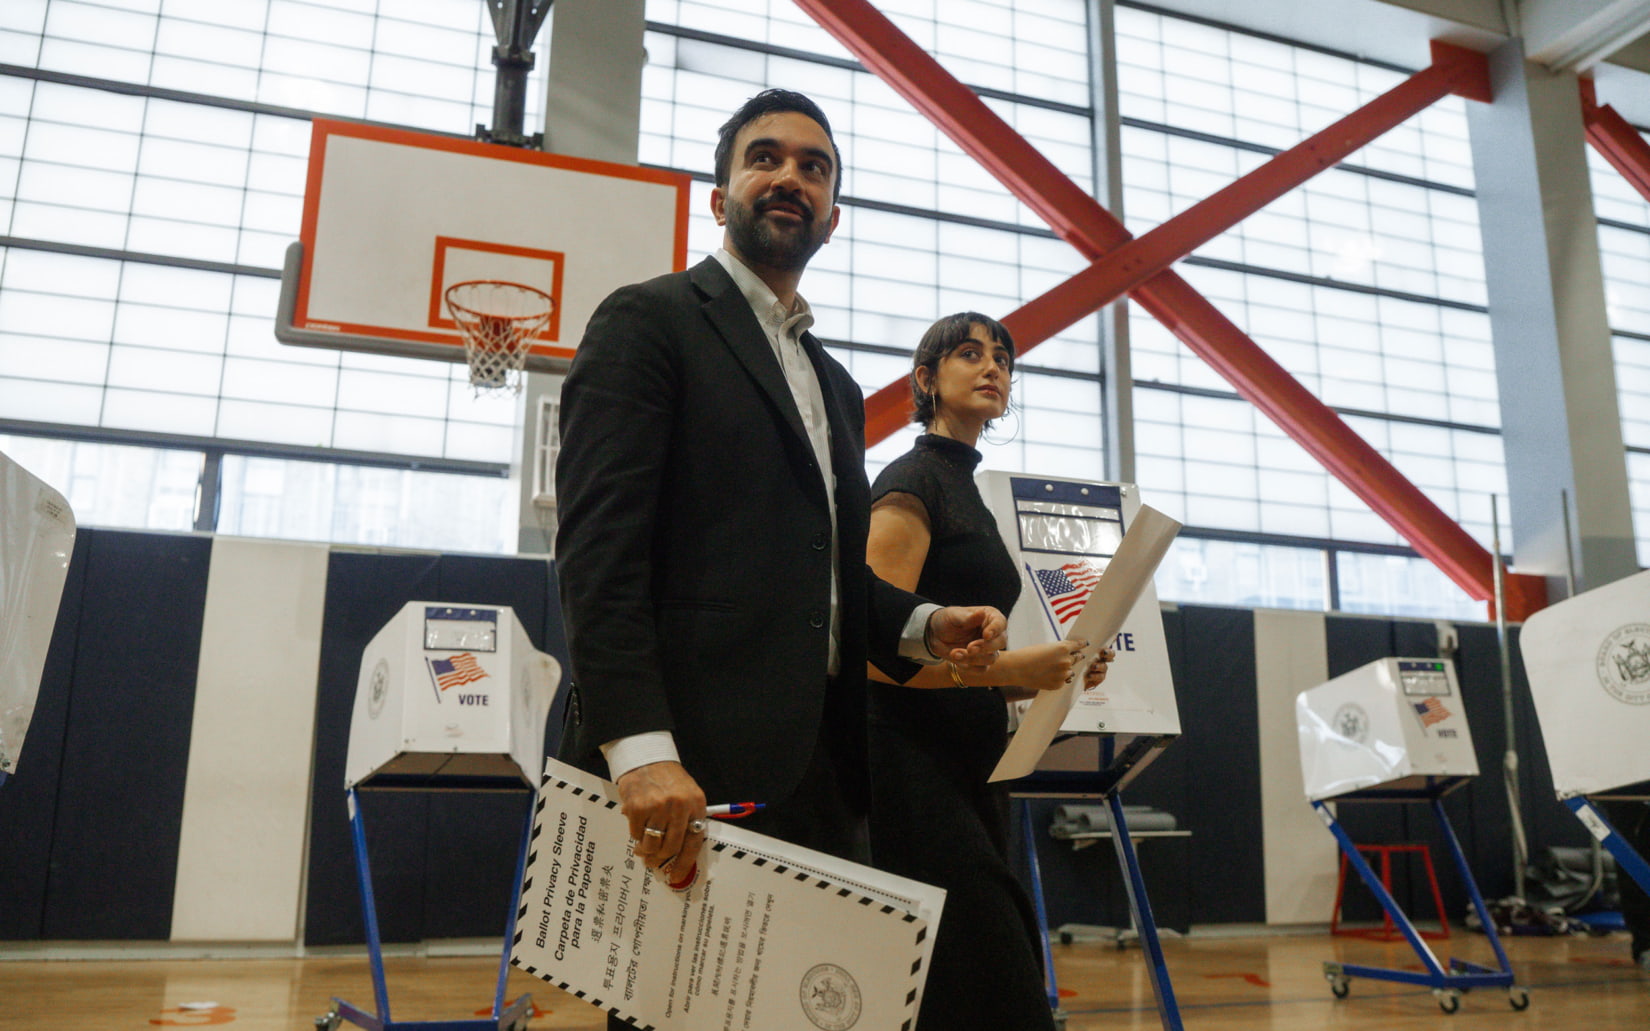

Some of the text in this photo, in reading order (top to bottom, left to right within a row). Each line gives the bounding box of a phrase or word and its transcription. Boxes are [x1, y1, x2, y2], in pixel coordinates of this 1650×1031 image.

[1109, 632, 1136, 651] TE
[458, 694, 489, 706] VOTE
[535, 811, 568, 949] Ballot Privacy Sleeve
[554, 815, 588, 962] Carpeta de Privacidad
[703, 879, 713, 902] sobre
[570, 840, 596, 949] para la Papeleta
[680, 901, 691, 933] marking
[693, 902, 708, 952] instrucciones
[602, 941, 621, 991] 투표용지
[612, 874, 633, 939] 프라이버시
[677, 932, 684, 944] on
[670, 943, 683, 987] instructions
[691, 952, 699, 964] las
[697, 948, 707, 975] marcar
[702, 937, 709, 948] su
[687, 977, 695, 996] para
[664, 998, 673, 1019] Open
[683, 994, 692, 1014] Abrir
